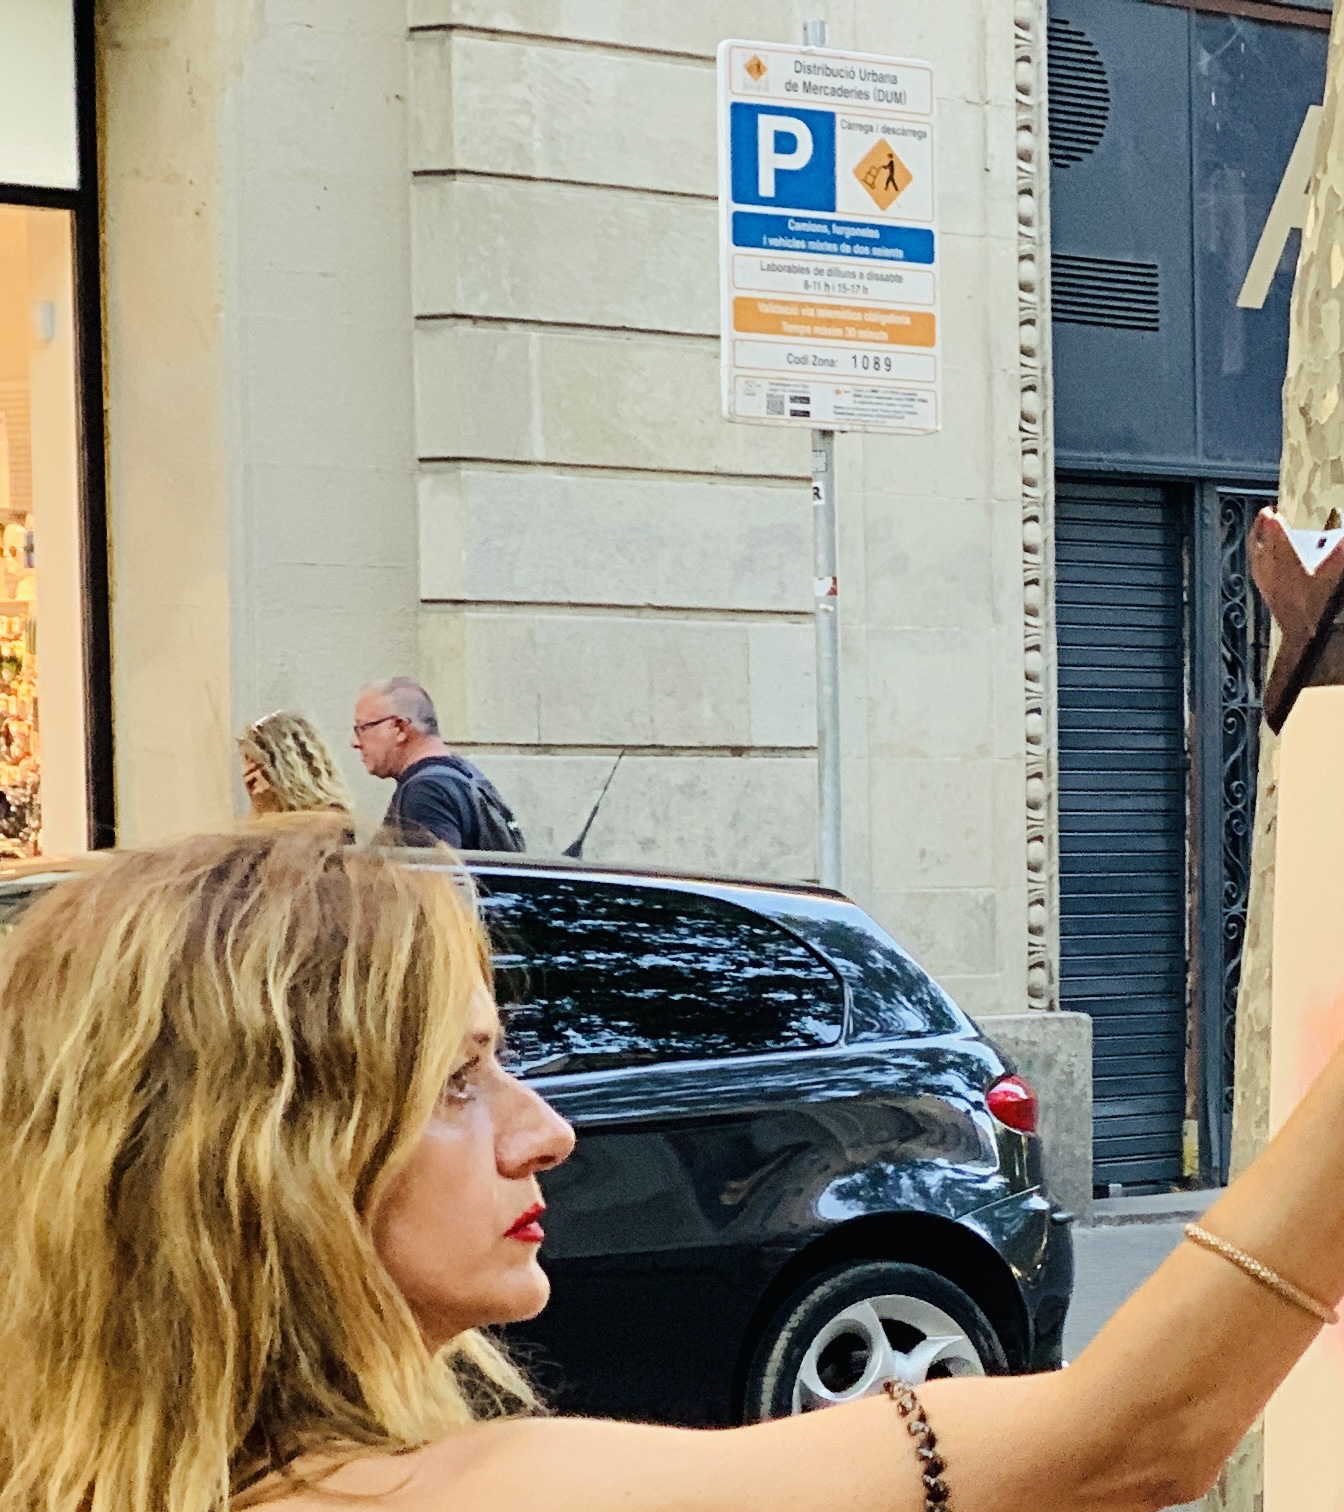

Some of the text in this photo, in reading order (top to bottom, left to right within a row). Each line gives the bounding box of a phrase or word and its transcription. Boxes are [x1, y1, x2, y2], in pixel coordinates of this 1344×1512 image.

[794, 60, 898, 85] Distribució Urbana
[785, 81, 798, 93] de
[803, 81, 870, 102] Mercaderies
[873, 88, 907, 106] (DUM)
[757, 113, 814, 198] P
[760, 261, 810, 276] Laborables
[814, 265, 824, 276] de
[787, 353, 808, 366] Codi
[812, 355, 838, 368] Zona:
